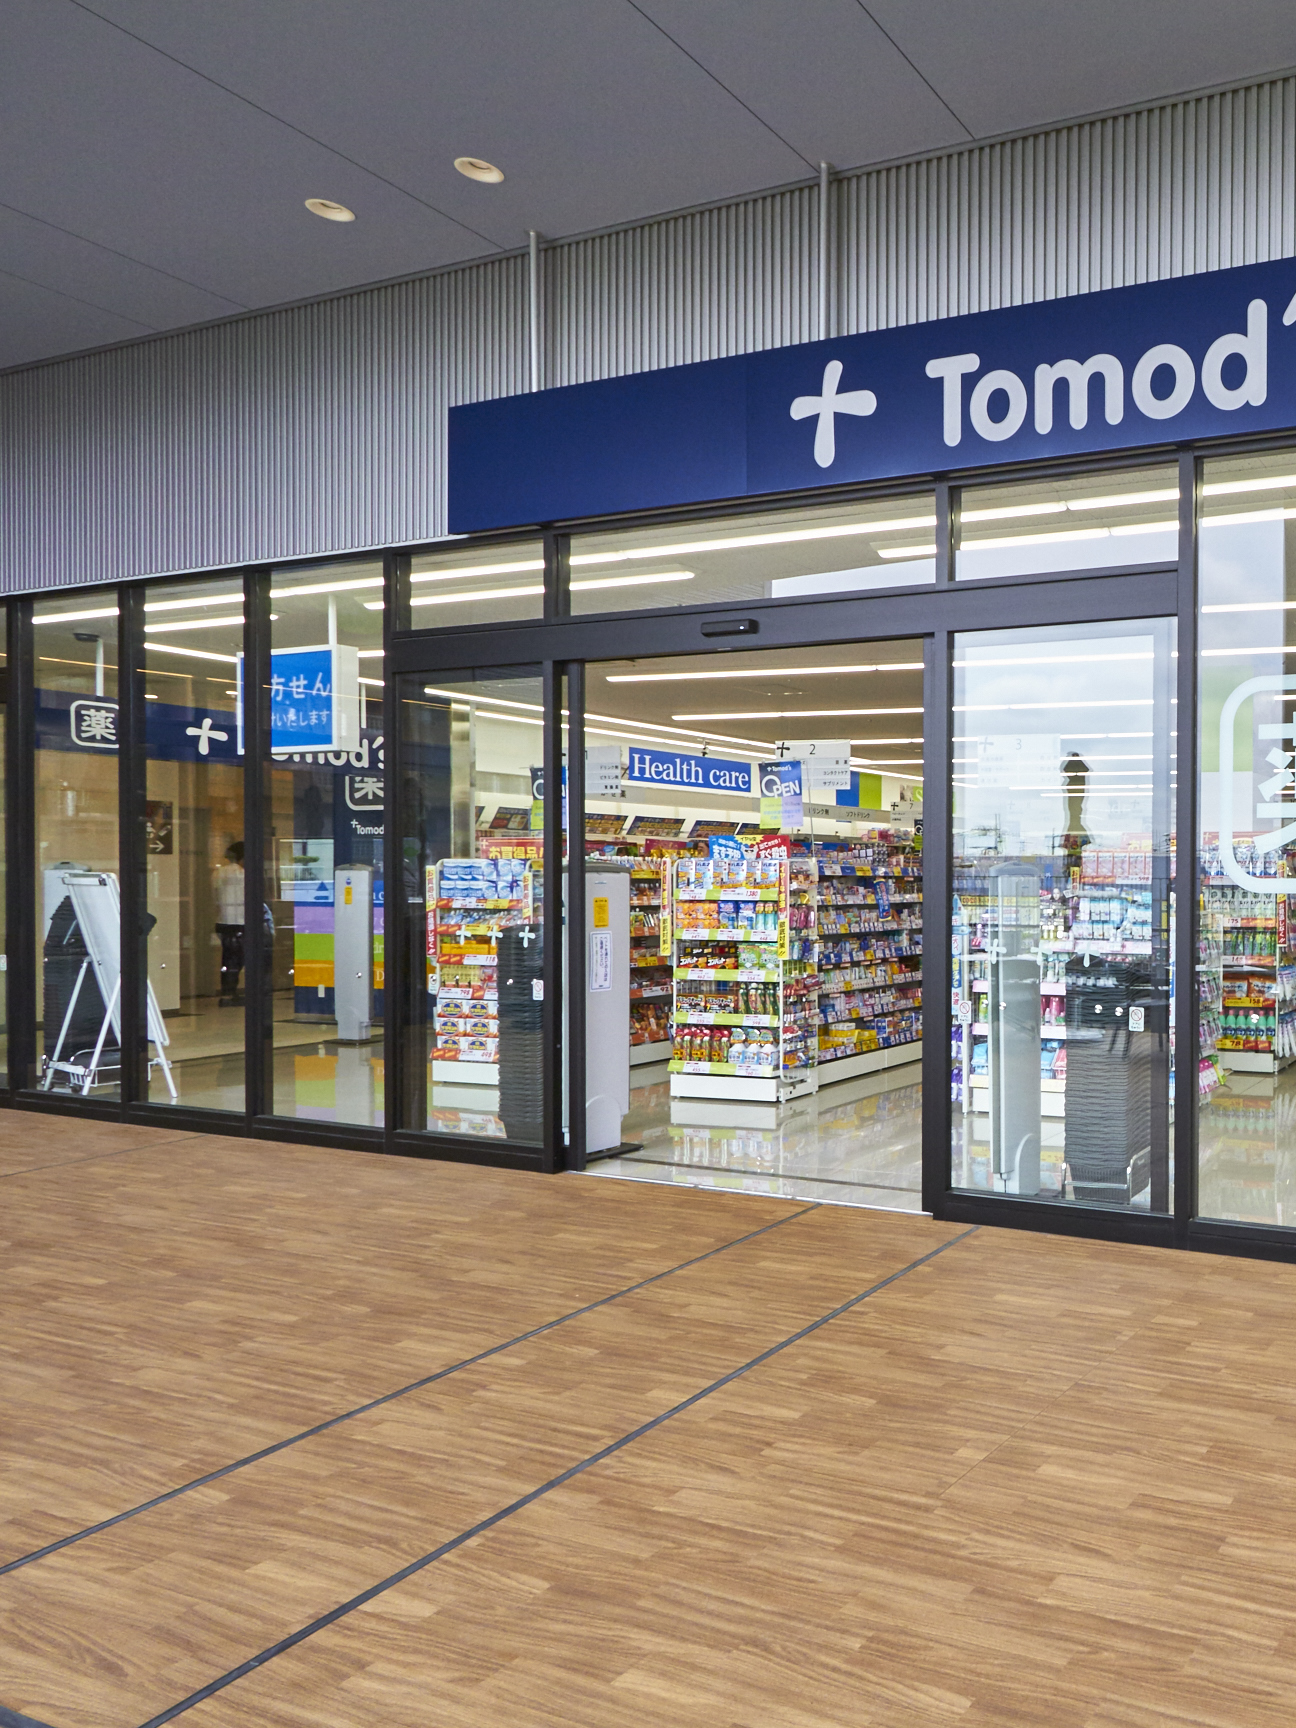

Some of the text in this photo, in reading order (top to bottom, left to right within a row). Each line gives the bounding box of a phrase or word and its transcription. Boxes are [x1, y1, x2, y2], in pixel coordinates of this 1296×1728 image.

[81, 709, 117, 741] 薬
[809, 743, 816, 755] 2
[1015, 738, 1022, 750] 3
[632, 753, 750, 789] Health care
[761, 774, 800, 799] OPEN
